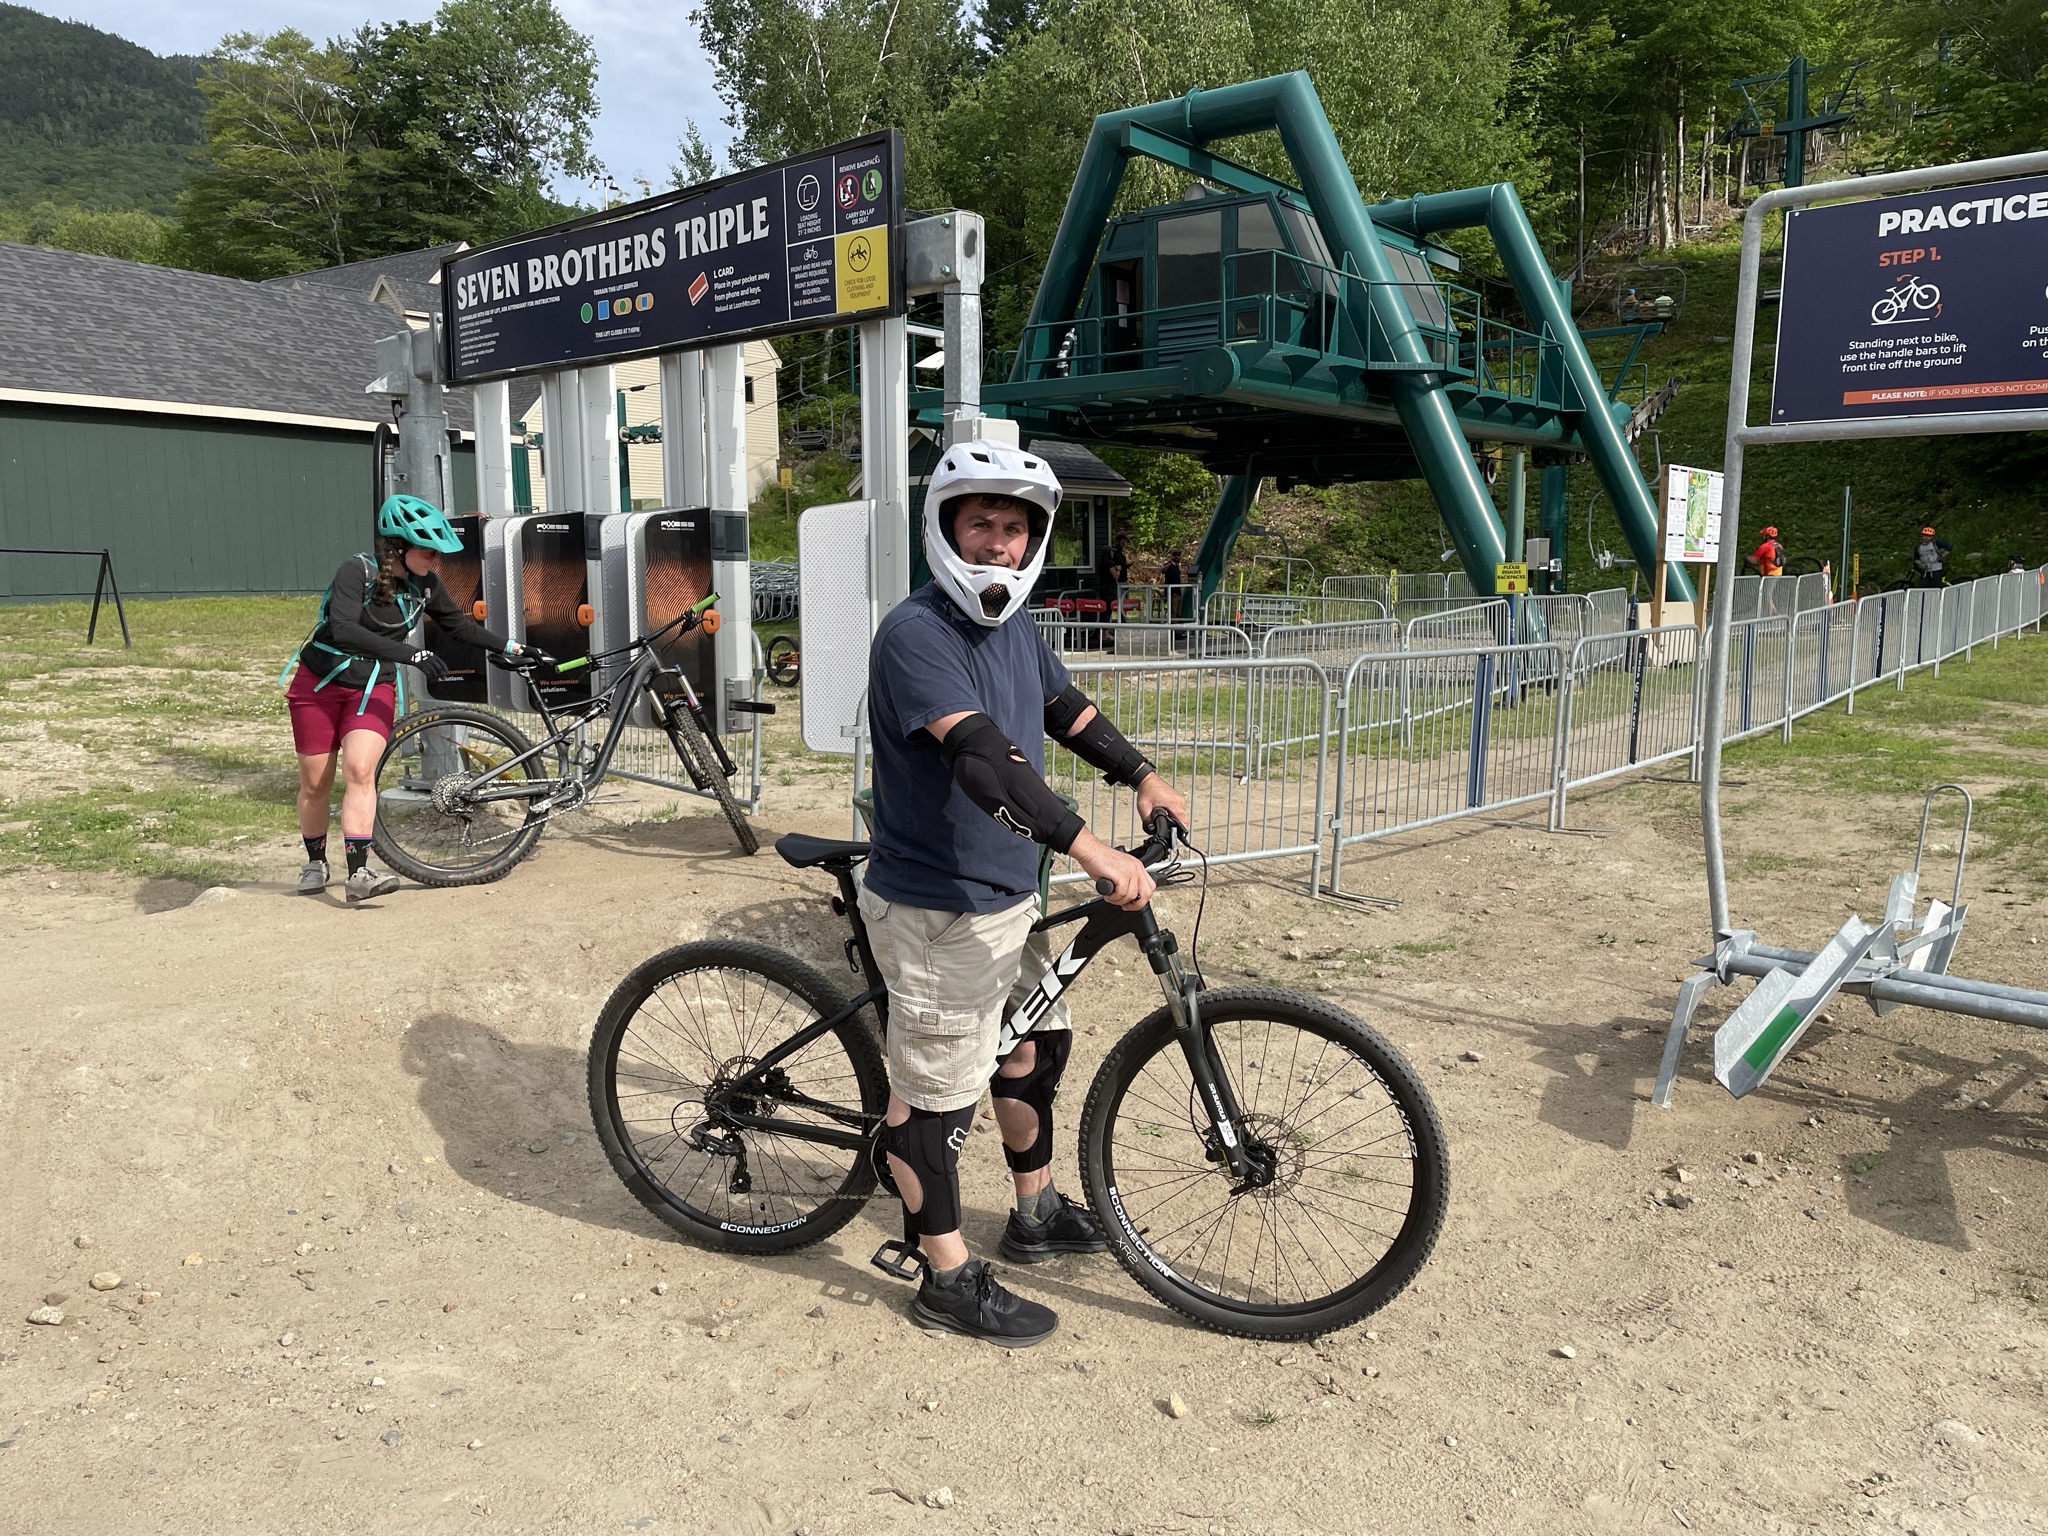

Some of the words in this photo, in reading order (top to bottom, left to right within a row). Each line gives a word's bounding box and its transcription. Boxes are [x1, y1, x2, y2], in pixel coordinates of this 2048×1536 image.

[839, 163, 856, 173] REMOVE
[800, 212, 818, 221] LOADING
[845, 210, 859, 220] CARRY
[859, 209, 866, 217] ON
[866, 207, 875, 215] LAP
[1878, 191, 2048, 238] PRACTICE
[797, 221, 807, 230] SEAT
[806, 218, 822, 227] HEIGHT
[851, 218, 858, 226] OR
[858, 216, 869, 225] SEAT
[807, 225, 821, 234] INCHES
[457, 262, 520, 311] SEVEN
[527, 227, 666, 293] BROTHERS
[674, 196, 770, 261] TRIPLE
[1879, 248, 1925, 267] STEP
[1929, 246, 1941, 261] 1.
[713, 270, 718, 279] L
[718, 266, 734, 278] CARD
[790, 264, 802, 273] FRONT
[810, 261, 820, 269] REAR
[820, 259, 832, 268] HAND
[714, 281, 726, 290] Place
[726, 280, 731, 288] in
[731, 278, 742, 288] your
[741, 274, 757, 286] pocket
[757, 271, 771, 281] away
[795, 271, 809, 280] BRAKES
[844, 278, 856, 287] CHECK
[863, 275, 876, 283] LOOSE
[794, 281, 807, 290] FRONT
[806, 277, 829, 288] SUSPENSION
[847, 285, 865, 293] CLOTHING
[865, 282, 874, 290] AND
[593, 288, 609, 296] TERRAIN
[608, 286, 616, 294] THIS
[714, 293, 726, 301] from
[725, 290, 740, 301] phone
[740, 287, 749, 296] and
[749, 285, 761, 296] keys.
[850, 290, 871, 299] EQUIPMENT
[534, 295, 561, 306] INSTRUCTIONS
[714, 304, 728, 313] Reload
[611, 328, 622, 336] CLOSES
[1849, 339, 1894, 350] Standing
[1896, 337, 1920, 346] next
[1921, 335, 1932, 344] to
[1934, 332, 1959, 343] bike,
[2022, 340, 2037, 348] on
[1839, 353, 1857, 362] use
[1859, 350, 1877, 361] the
[1878, 347, 1913, 359] handle
[1915, 345, 1938, 356] bars
[1939, 344, 1951, 354] to
[1953, 343, 1967, 353] lift
[1842, 363, 1867, 374] front
[1869, 361, 1886, 371] tire
[1888, 359, 1903, 370] off
[1904, 358, 1921, 368] the
[1923, 355, 1962, 369] ground
[1872, 391, 1902, 400] PLEASE
[1903, 390, 1928, 399] NOTE:
[1937, 387, 1960, 396] YOUR
[1961, 386, 1980, 395] BIKE
[1981, 385, 2005, 394] DOES
[2006, 384, 2024, 392] NOT
[540, 686, 568, 694] solutions.
[395, 714, 440, 739] MAXXIS
[989, 938, 1088, 1078] REK
[727, 1215, 807, 1235] CONNECTION
[1111, 1194, 1171, 1278] CONNECTION
[1115, 1235, 1139, 1266] XR2
